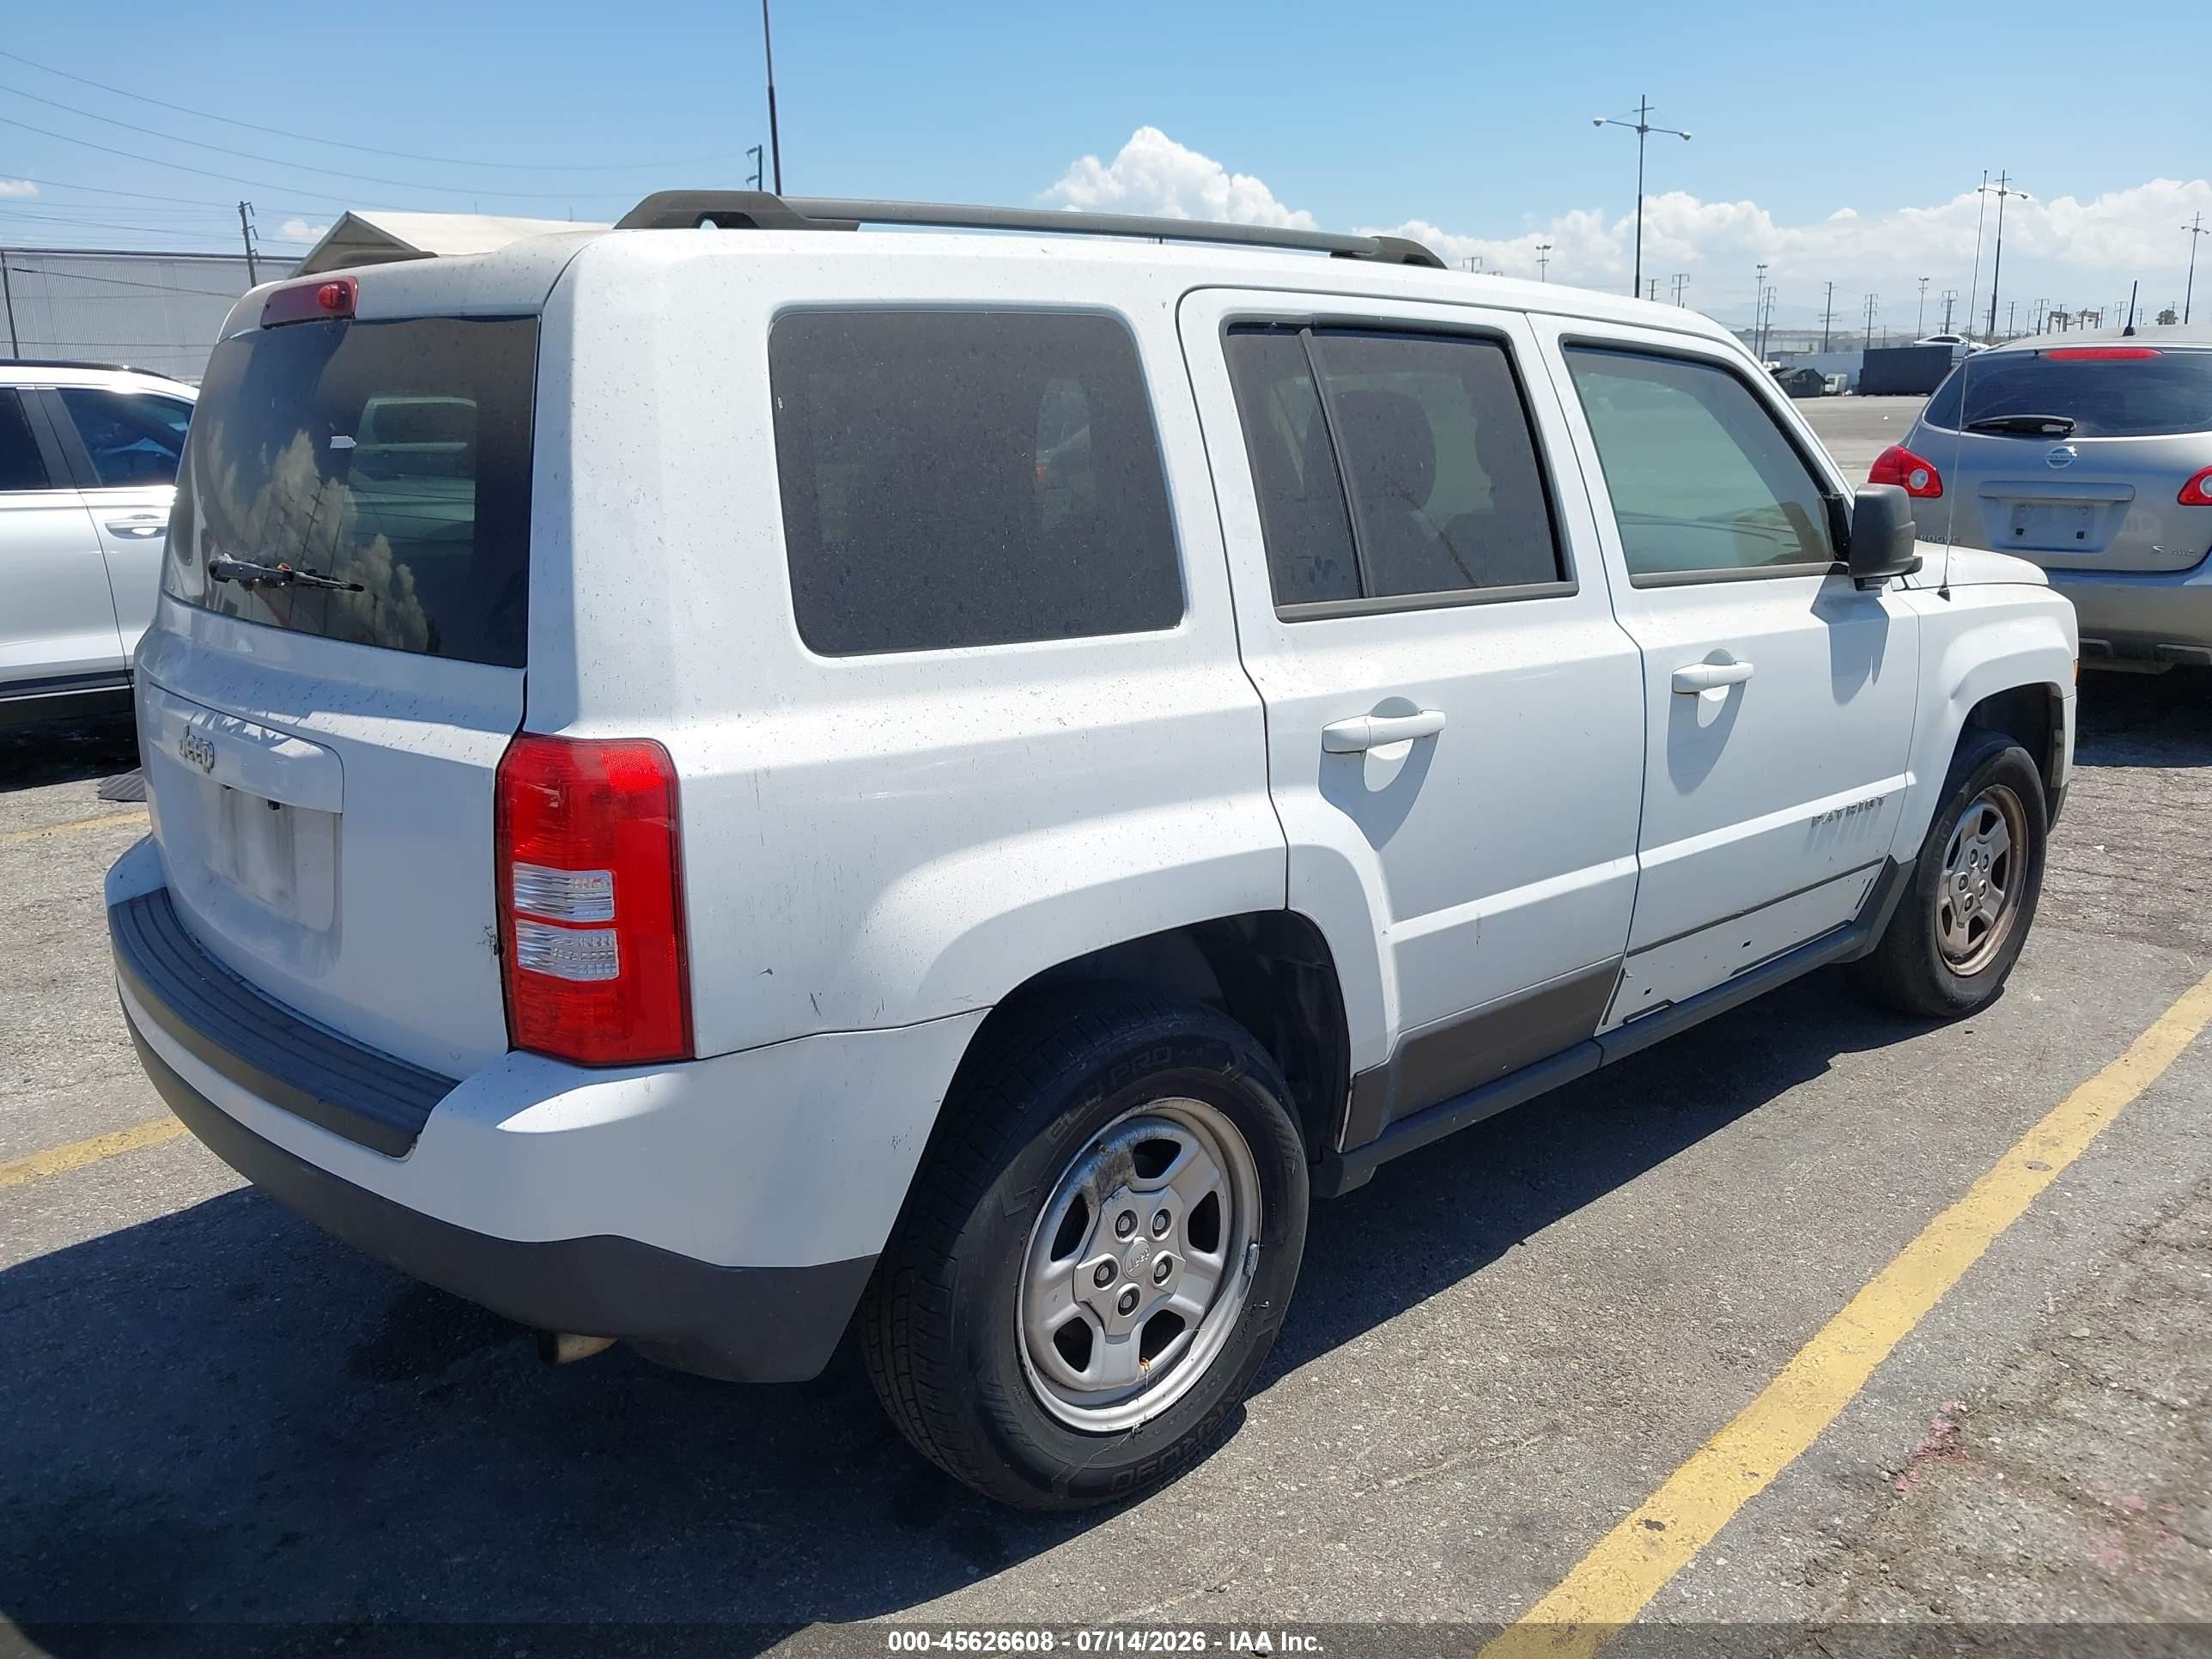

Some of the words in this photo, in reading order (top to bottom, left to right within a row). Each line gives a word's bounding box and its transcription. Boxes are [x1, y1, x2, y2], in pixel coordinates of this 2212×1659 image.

[179, 723, 215, 774] Jeep
[1811, 793, 1888, 828] PATRIOT
[1127, 1247, 1150, 1273] Jeep
